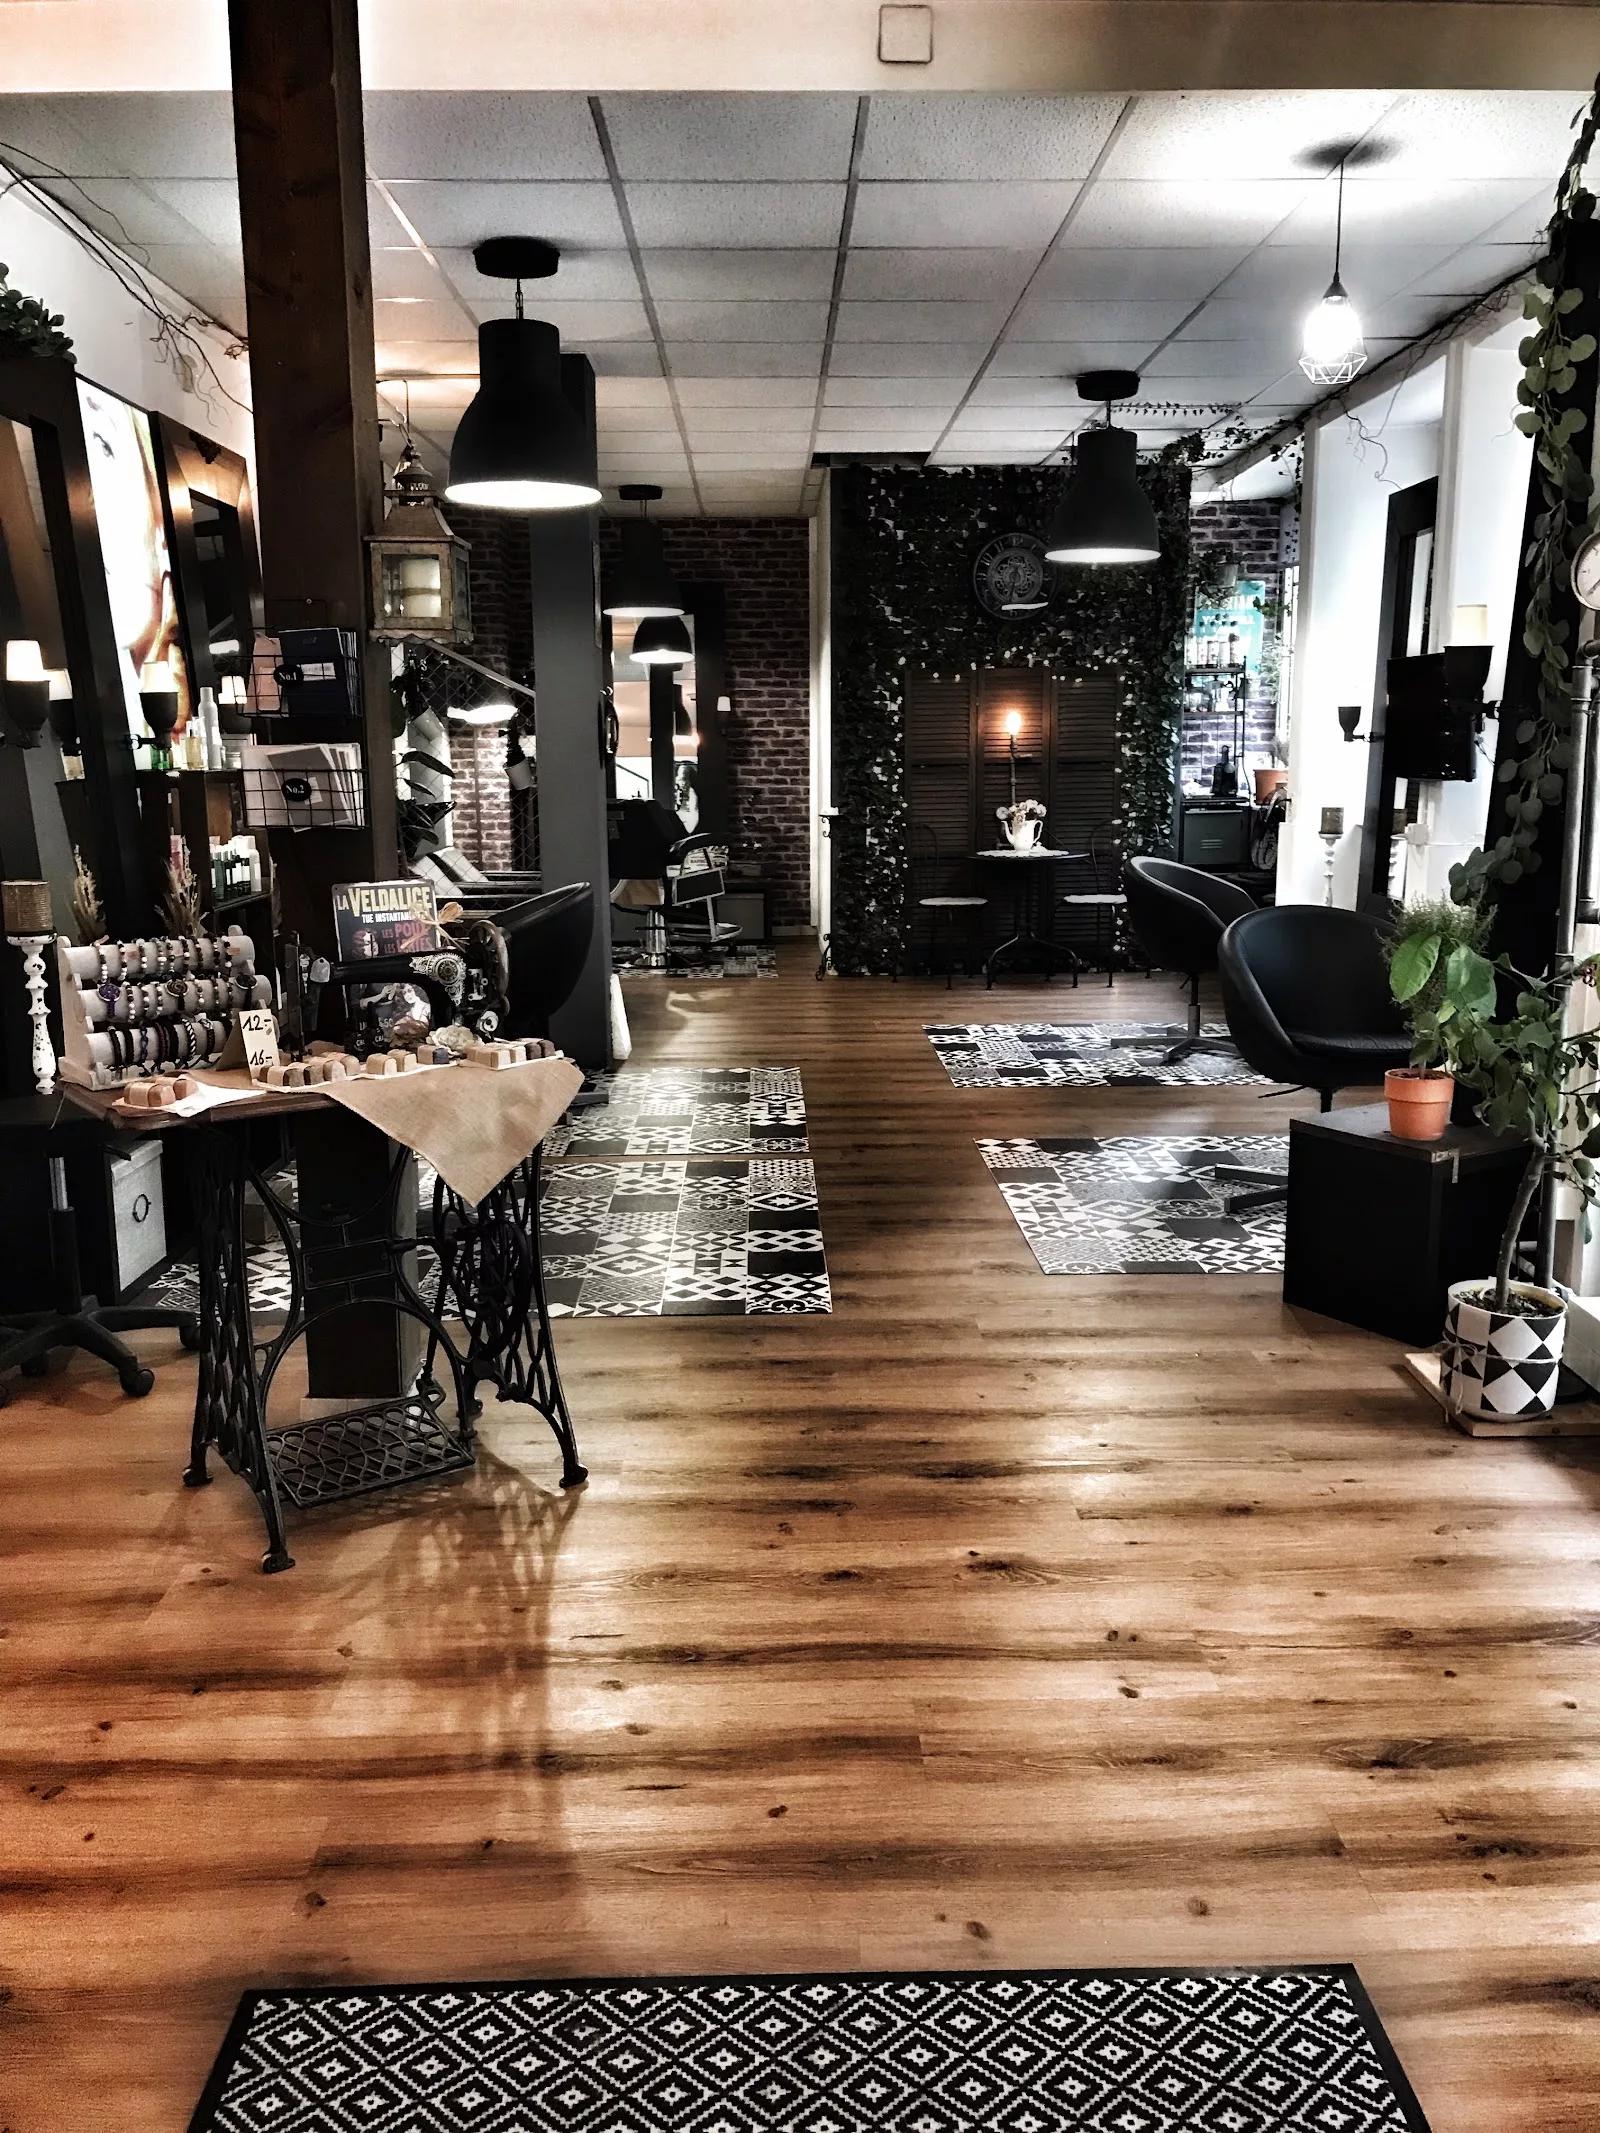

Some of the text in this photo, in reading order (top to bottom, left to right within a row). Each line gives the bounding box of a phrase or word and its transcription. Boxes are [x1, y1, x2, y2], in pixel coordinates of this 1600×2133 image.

[285, 784, 305, 794] No.2
[337, 895, 349, 910] LA
[362, 913, 374, 923] TUE
